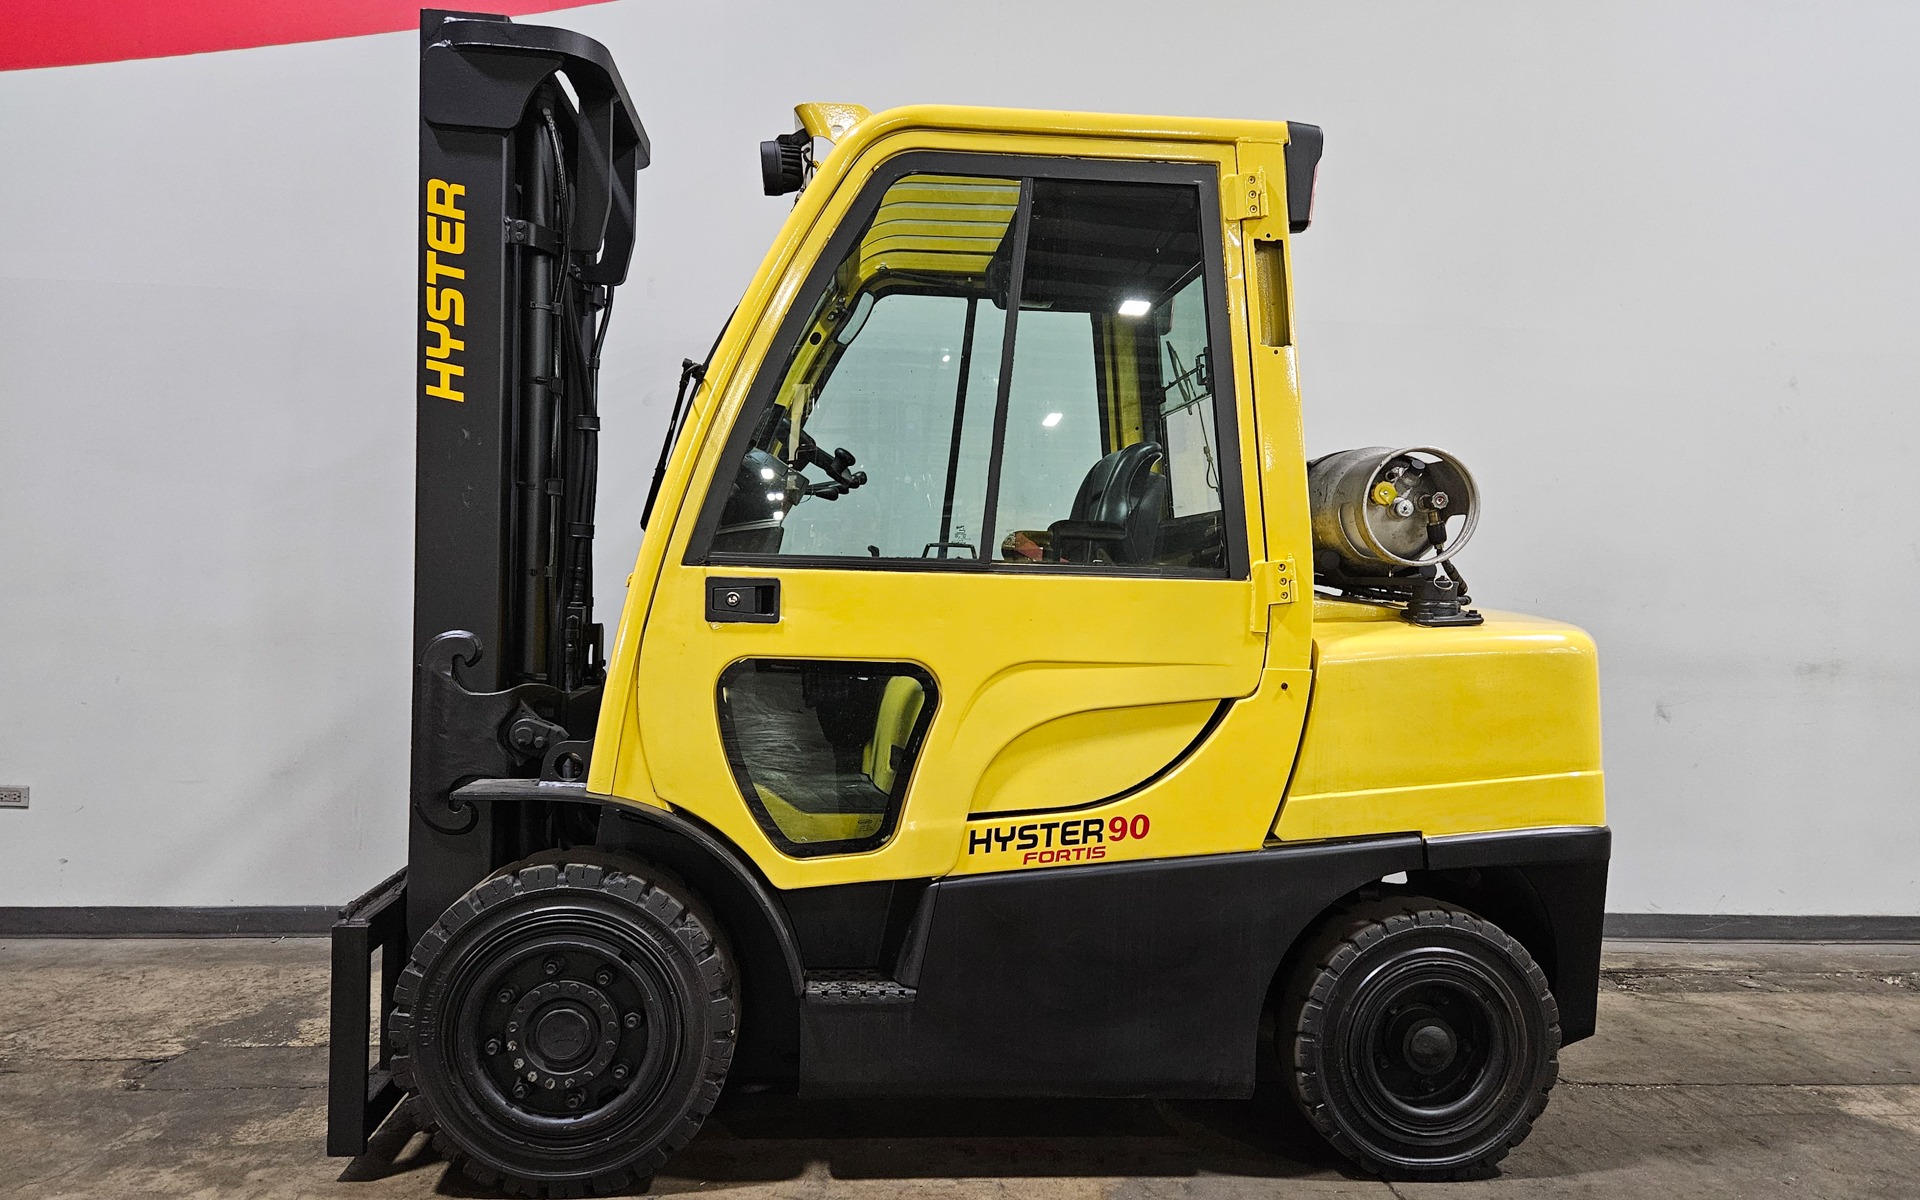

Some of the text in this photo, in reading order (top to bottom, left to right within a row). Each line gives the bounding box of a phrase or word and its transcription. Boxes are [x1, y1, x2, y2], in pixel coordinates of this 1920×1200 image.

[426, 178, 465, 402] HYSTER
[968, 813, 1150, 855] HYSTER 90
[1023, 846, 1106, 865] FORTIS
